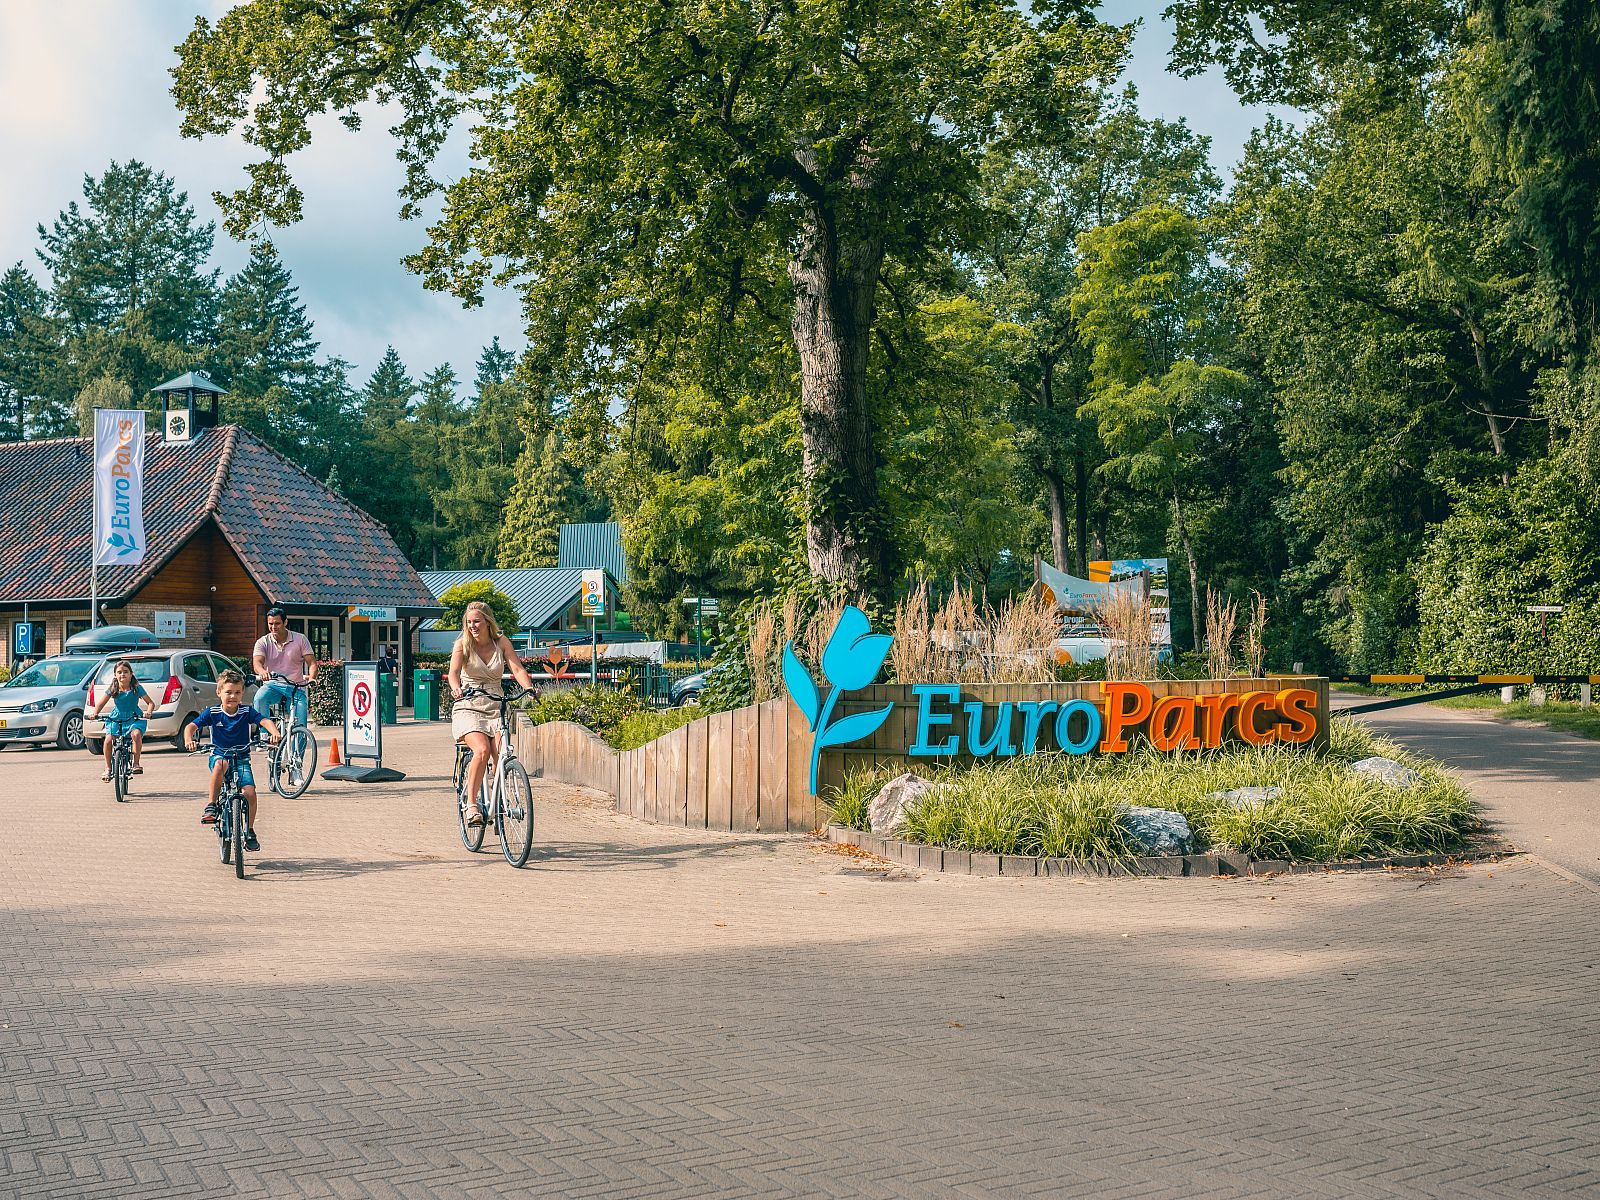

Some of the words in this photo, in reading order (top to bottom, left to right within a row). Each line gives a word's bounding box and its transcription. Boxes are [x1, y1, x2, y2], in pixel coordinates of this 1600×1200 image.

[111, 419, 132, 530] EuroParcs
[19, 626, 27, 641] P
[358, 608, 387, 619] Receptie
[909, 682, 1318, 756] EuroParcs
